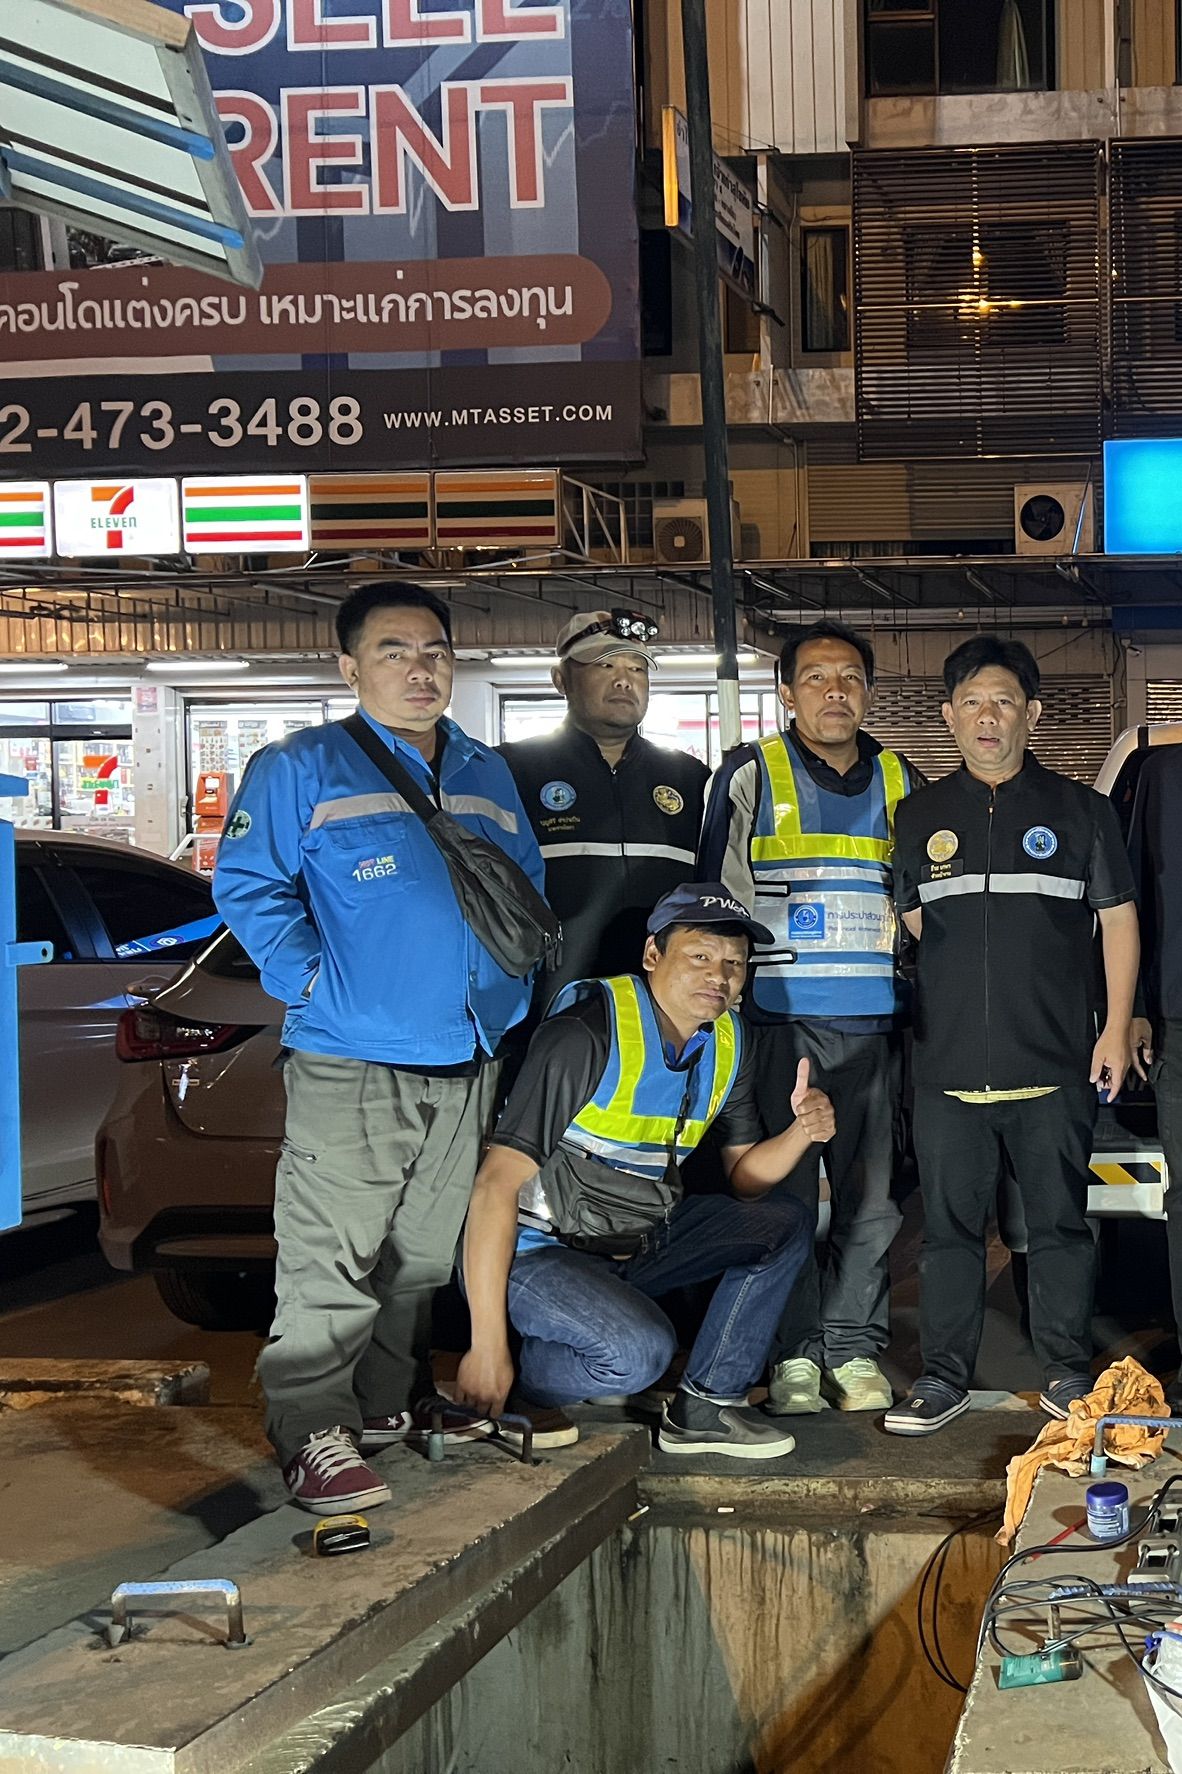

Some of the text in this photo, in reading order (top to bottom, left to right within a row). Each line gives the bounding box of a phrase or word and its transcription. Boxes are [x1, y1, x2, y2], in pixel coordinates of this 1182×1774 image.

[212, 76, 574, 218] RENT
[259, 269, 573, 330] เหมาะแก่การลงทุน
[0, 395, 613, 454] 2-473-3488 WWW.MTASSET.COM
[91, 485, 134, 549] 7
[352, 863, 398, 882] 1662
